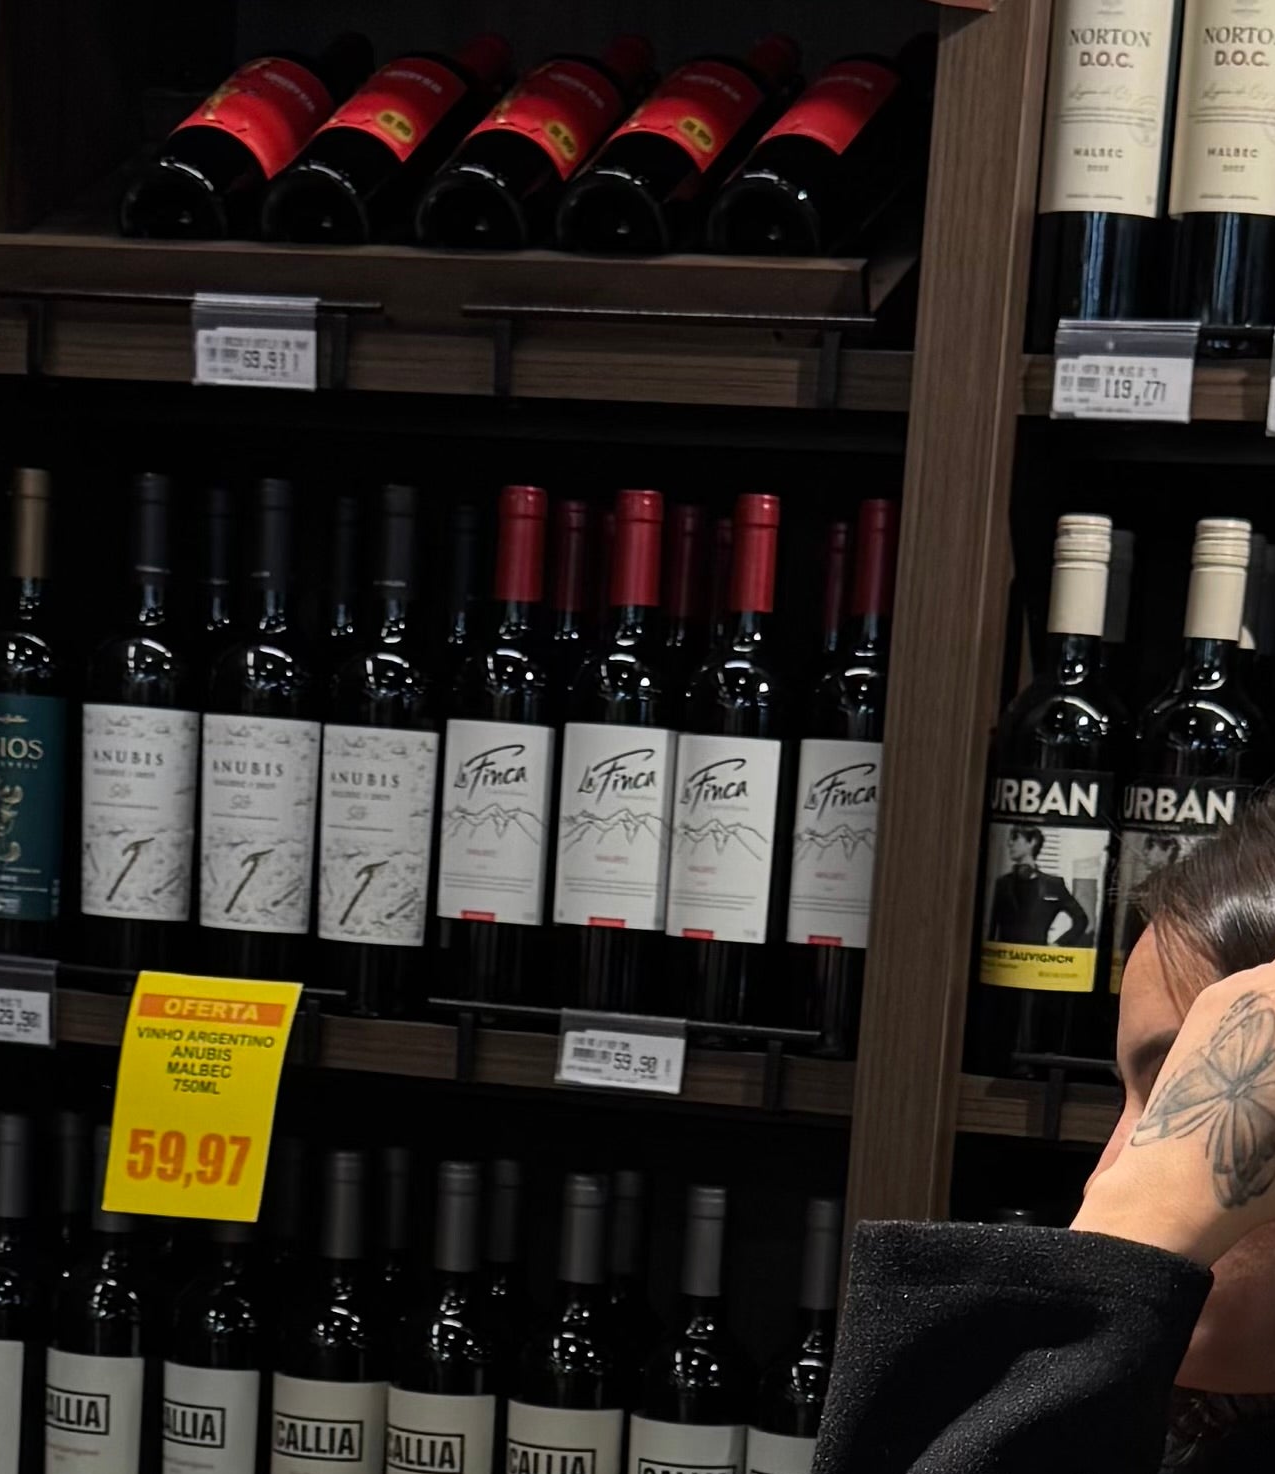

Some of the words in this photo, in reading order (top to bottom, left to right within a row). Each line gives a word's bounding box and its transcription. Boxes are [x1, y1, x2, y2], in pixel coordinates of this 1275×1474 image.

[1069, 28, 1152, 48] NORTON
[1079, 50, 1135, 69] D.O.C.
[1213, 50, 1270, 68] D.O.C.
[164, 998, 259, 1021] OFERTA
[137, 1026, 183, 1041] VINHO
[186, 1030, 275, 1048] ARGENTINO
[171, 1046, 232, 1062] ANUBIS
[166, 1062, 232, 1079] MALBEC
[173, 1079, 221, 1095] 750ML
[126, 1128, 252, 1189] 59,97
[47, 1394, 101, 1429] LLIA
[164, 1405, 217, 1442] ALLIA
[276, 1420, 355, 1456] CALLIA
